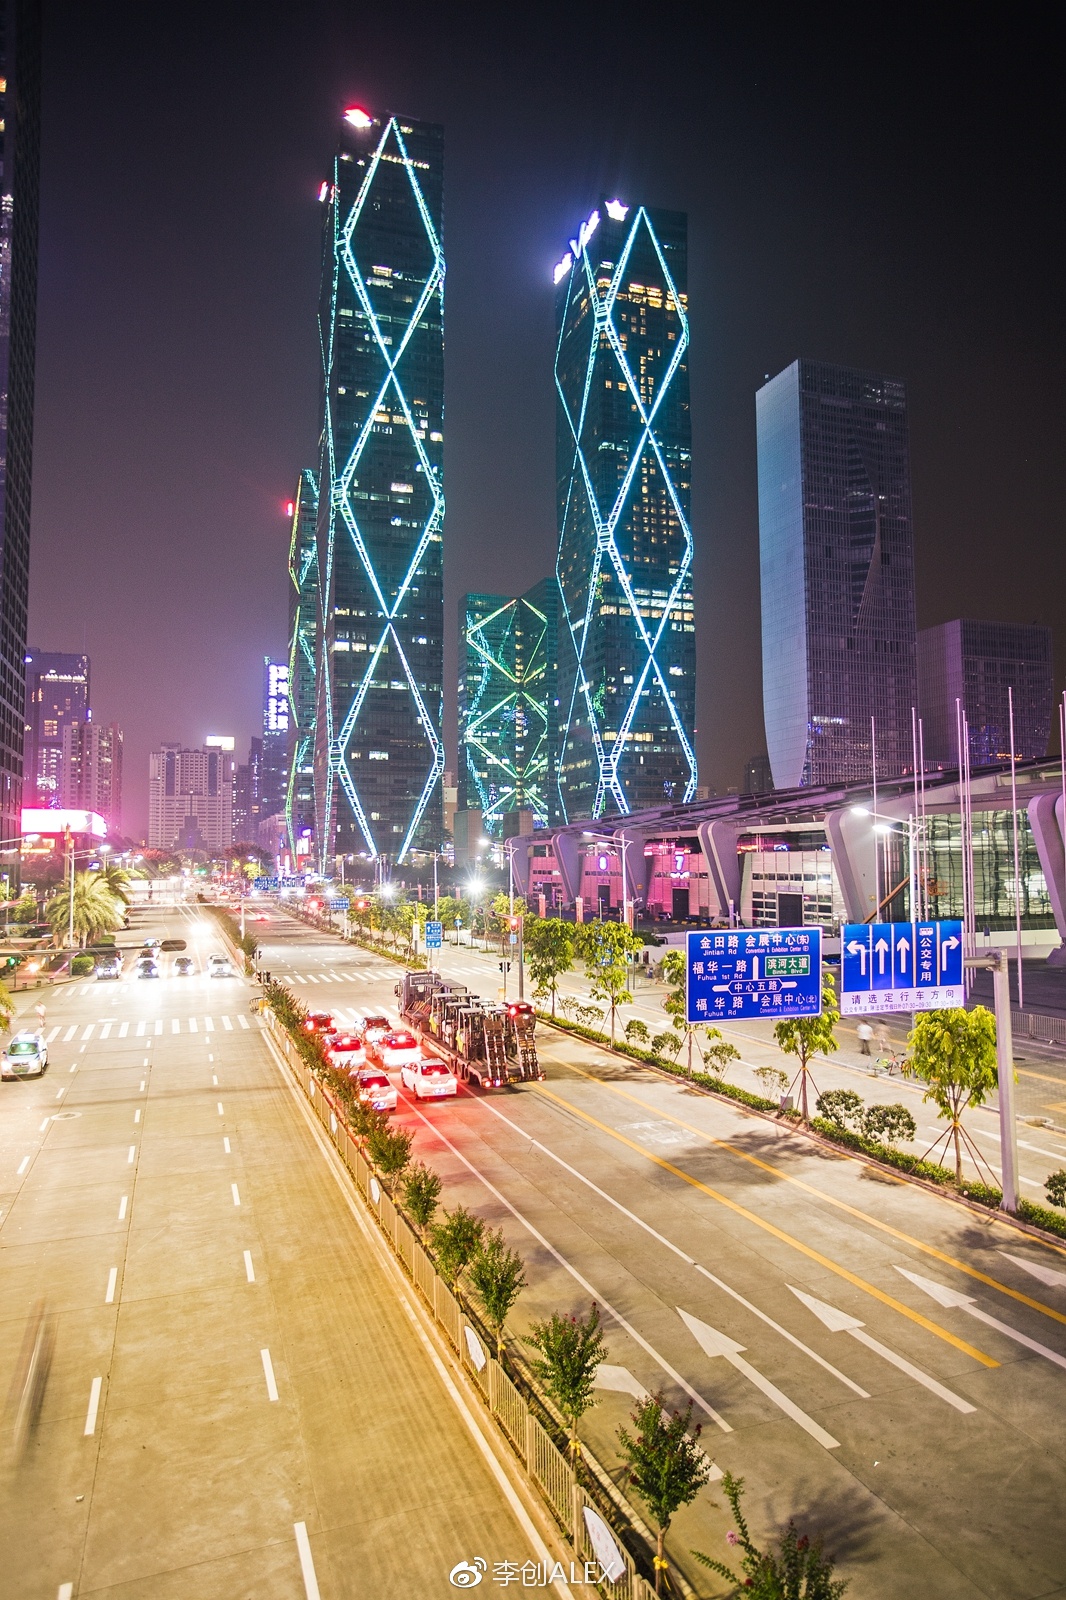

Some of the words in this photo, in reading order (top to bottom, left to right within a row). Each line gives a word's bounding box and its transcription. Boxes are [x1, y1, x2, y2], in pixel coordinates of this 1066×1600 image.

[675, 855, 684, 871] 7
[700, 936, 739, 949] 金田路
[745, 934, 810, 947] 会展中心(东)
[768, 957, 808, 969] 滨河大道
[920, 937, 932, 982] 公交专用
[693, 960, 747, 974] 福华一路
[734, 981, 778, 992] 中心五路
[696, 996, 744, 1011] 福华路
[761, 993, 818, 1007] 会展中心(北)
[852, 990, 954, 1004] 请选定行车方向
